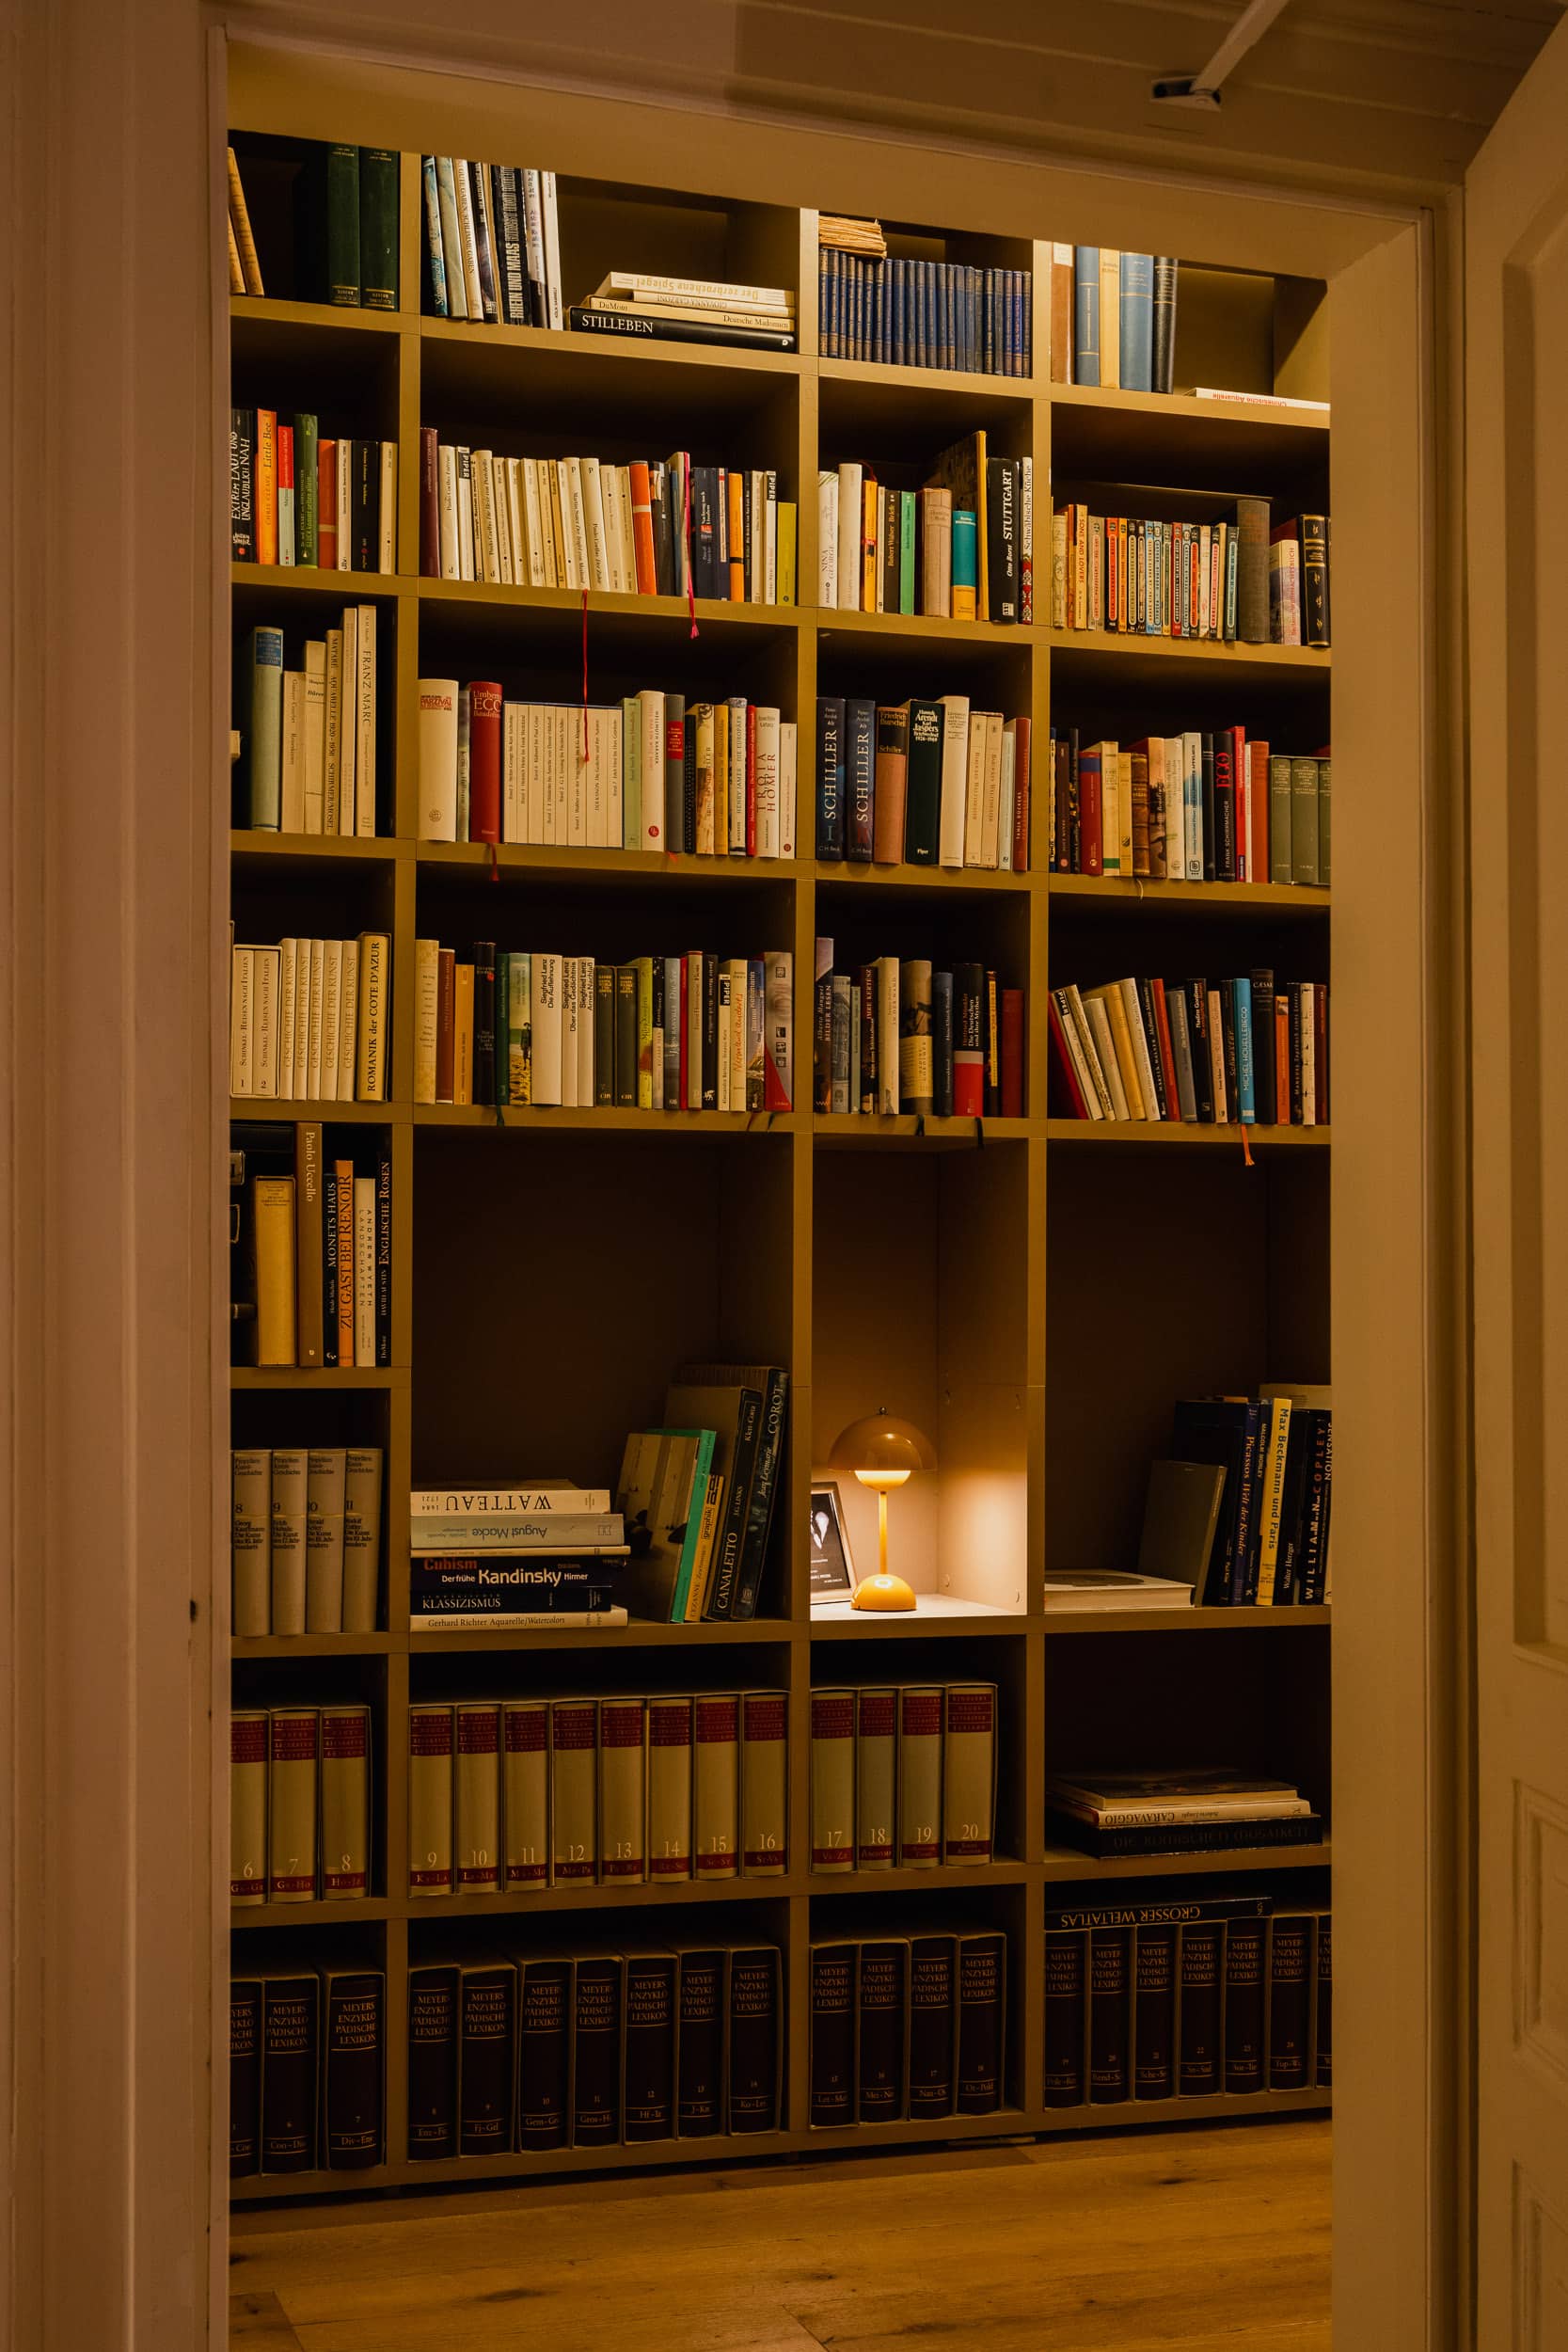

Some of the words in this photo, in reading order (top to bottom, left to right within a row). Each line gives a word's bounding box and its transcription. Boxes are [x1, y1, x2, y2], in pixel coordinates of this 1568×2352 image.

[504, 242, 521, 271] MAAS
[507, 272, 523, 291] UND
[636, 277, 675, 291] Spiegel
[509, 293, 525, 319] RHEIN
[599, 301, 627, 311] DuMont
[581, 314, 654, 334] STILLEBEN
[723, 314, 753, 326] Deutsche
[1212, 392, 1245, 403] Aquarelle
[230, 431, 239, 450] UND
[262, 422, 272, 439] Bee
[240, 437, 251, 466] NAH
[262, 442, 272, 468] Little
[230, 451, 240, 481] LAUT
[768, 476, 776, 501] PIPER
[1022, 466, 1032, 493] Küche
[230, 483, 241, 519] EXTREM
[1002, 469, 1013, 540] STUTTGART
[1023, 494, 1033, 550] Schwäbische
[821, 548, 830, 572] NINA
[887, 544, 895, 566] Robert
[361, 650, 372, 689] FRANZ
[361, 692, 372, 726] MARC
[474, 698, 502, 713] ECO
[824, 729, 837, 820] SCHILLER
[856, 732, 869, 822] SCHILLER
[1215, 752, 1232, 788] EGO
[756, 753, 767, 813] TROIA
[767, 754, 776, 812] HOMER
[285, 955, 293, 985] KUNST
[299, 955, 309, 986] KUNST
[312, 956, 322, 987] KUNST
[327, 955, 338, 987] KUNST
[346, 956, 356, 988] KUNST
[370, 942, 380, 983] D'AZUR
[569, 961, 578, 1000] Gedächtnis
[285, 989, 293, 1007] DER
[299, 989, 308, 1008] DER
[311, 990, 321, 1009] DER
[326, 990, 336, 1009] DER
[345, 991, 354, 1009] DER
[369, 986, 379, 1017] COTE
[562, 978, 571, 1009] Siegfried
[579, 978, 588, 1009] Siegfried
[817, 984, 826, 1013] Manguel
[1057, 991, 1069, 1015] PIPER
[368, 1019, 377, 1035] der
[816, 1014, 825, 1041] Alberto
[1194, 1009, 1202, 1028] Nadine
[284, 1010, 293, 1068] GESCHICHTE
[297, 1011, 307, 1069] GESCHICHTE
[309, 1011, 320, 1069] GESCHICHTE
[325, 1011, 336, 1069] GESCHICHTE
[344, 1011, 353, 1069] GESCHICHTE
[1241, 1007, 1249, 1061] HOUELLEBECQ
[367, 1038, 377, 1092] ROMANIK
[306, 1131, 315, 1160] Paolo
[306, 1164, 317, 1201] Uccello
[378, 1161, 390, 1200] ROSEN
[326, 1182, 337, 1215] HAUS
[338, 1174, 351, 1234] RENOIR
[326, 1217, 337, 1267] MONETS
[378, 1201, 390, 1265] ENGLISCHE
[339, 1239, 352, 1263] BEI
[340, 1265, 353, 1304] GAST
[339, 1308, 352, 1329] ZU
[766, 1384, 784, 1435] COROT
[1278, 1407, 1290, 1433] Max
[1242, 1435, 1256, 1480] Picassos
[1271, 1435, 1288, 1495] Beckmann
[445, 1495, 552, 1511] WATTEAU
[1241, 1482, 1253, 1506] Welt
[235, 1504, 243, 1514] 8
[273, 1502, 280, 1513] 9
[1241, 1505, 1249, 1522] der
[1270, 1497, 1281, 1516] und
[1304, 1521, 1319, 1599] WILLIAM
[1312, 1427, 1325, 1494] COPLEY
[472, 1526, 509, 1539] Macke
[512, 1524, 547, 1539] August
[702, 1507, 713, 1540] graphik
[1268, 1518, 1280, 1550] Paris
[1236, 1521, 1249, 1557] Kinder
[422, 1557, 478, 1571] Cubism
[717, 1532, 738, 1611] CANALETTO
[455, 1574, 476, 1582] frühe
[478, 1568, 562, 1588] Kandinsky
[1273, 1566, 1283, 1590] Walter
[422, 1597, 501, 1610] KLASSIZISMUS
[428, 1618, 459, 1628] Gerhard
[460, 1618, 487, 1628] Richter
[1104, 1812, 1175, 1825] CARAVAGGIO
[760, 1833, 777, 1851] 16
[827, 1831, 844, 1848] 17
[870, 1828, 886, 1844] 18
[916, 1826, 933, 1843] 19
[962, 1823, 979, 1840] 20
[521, 1847, 536, 1863] 11
[569, 1844, 586, 1862] 12
[617, 1842, 633, 1859] 13
[663, 1840, 680, 1857] 14
[711, 1836, 728, 1853] 15
[243, 1861, 254, 1878] 6
[288, 1858, 299, 1875] 7
[341, 1853, 352, 1872] 8
[427, 1851, 437, 1868] 9
[472, 1849, 488, 1867] 10
[1060, 1911, 1138, 1928] WELTATLAS
[1140, 1904, 1201, 1922] GROSSER
[340, 2033, 377, 2046] LEXIKON
